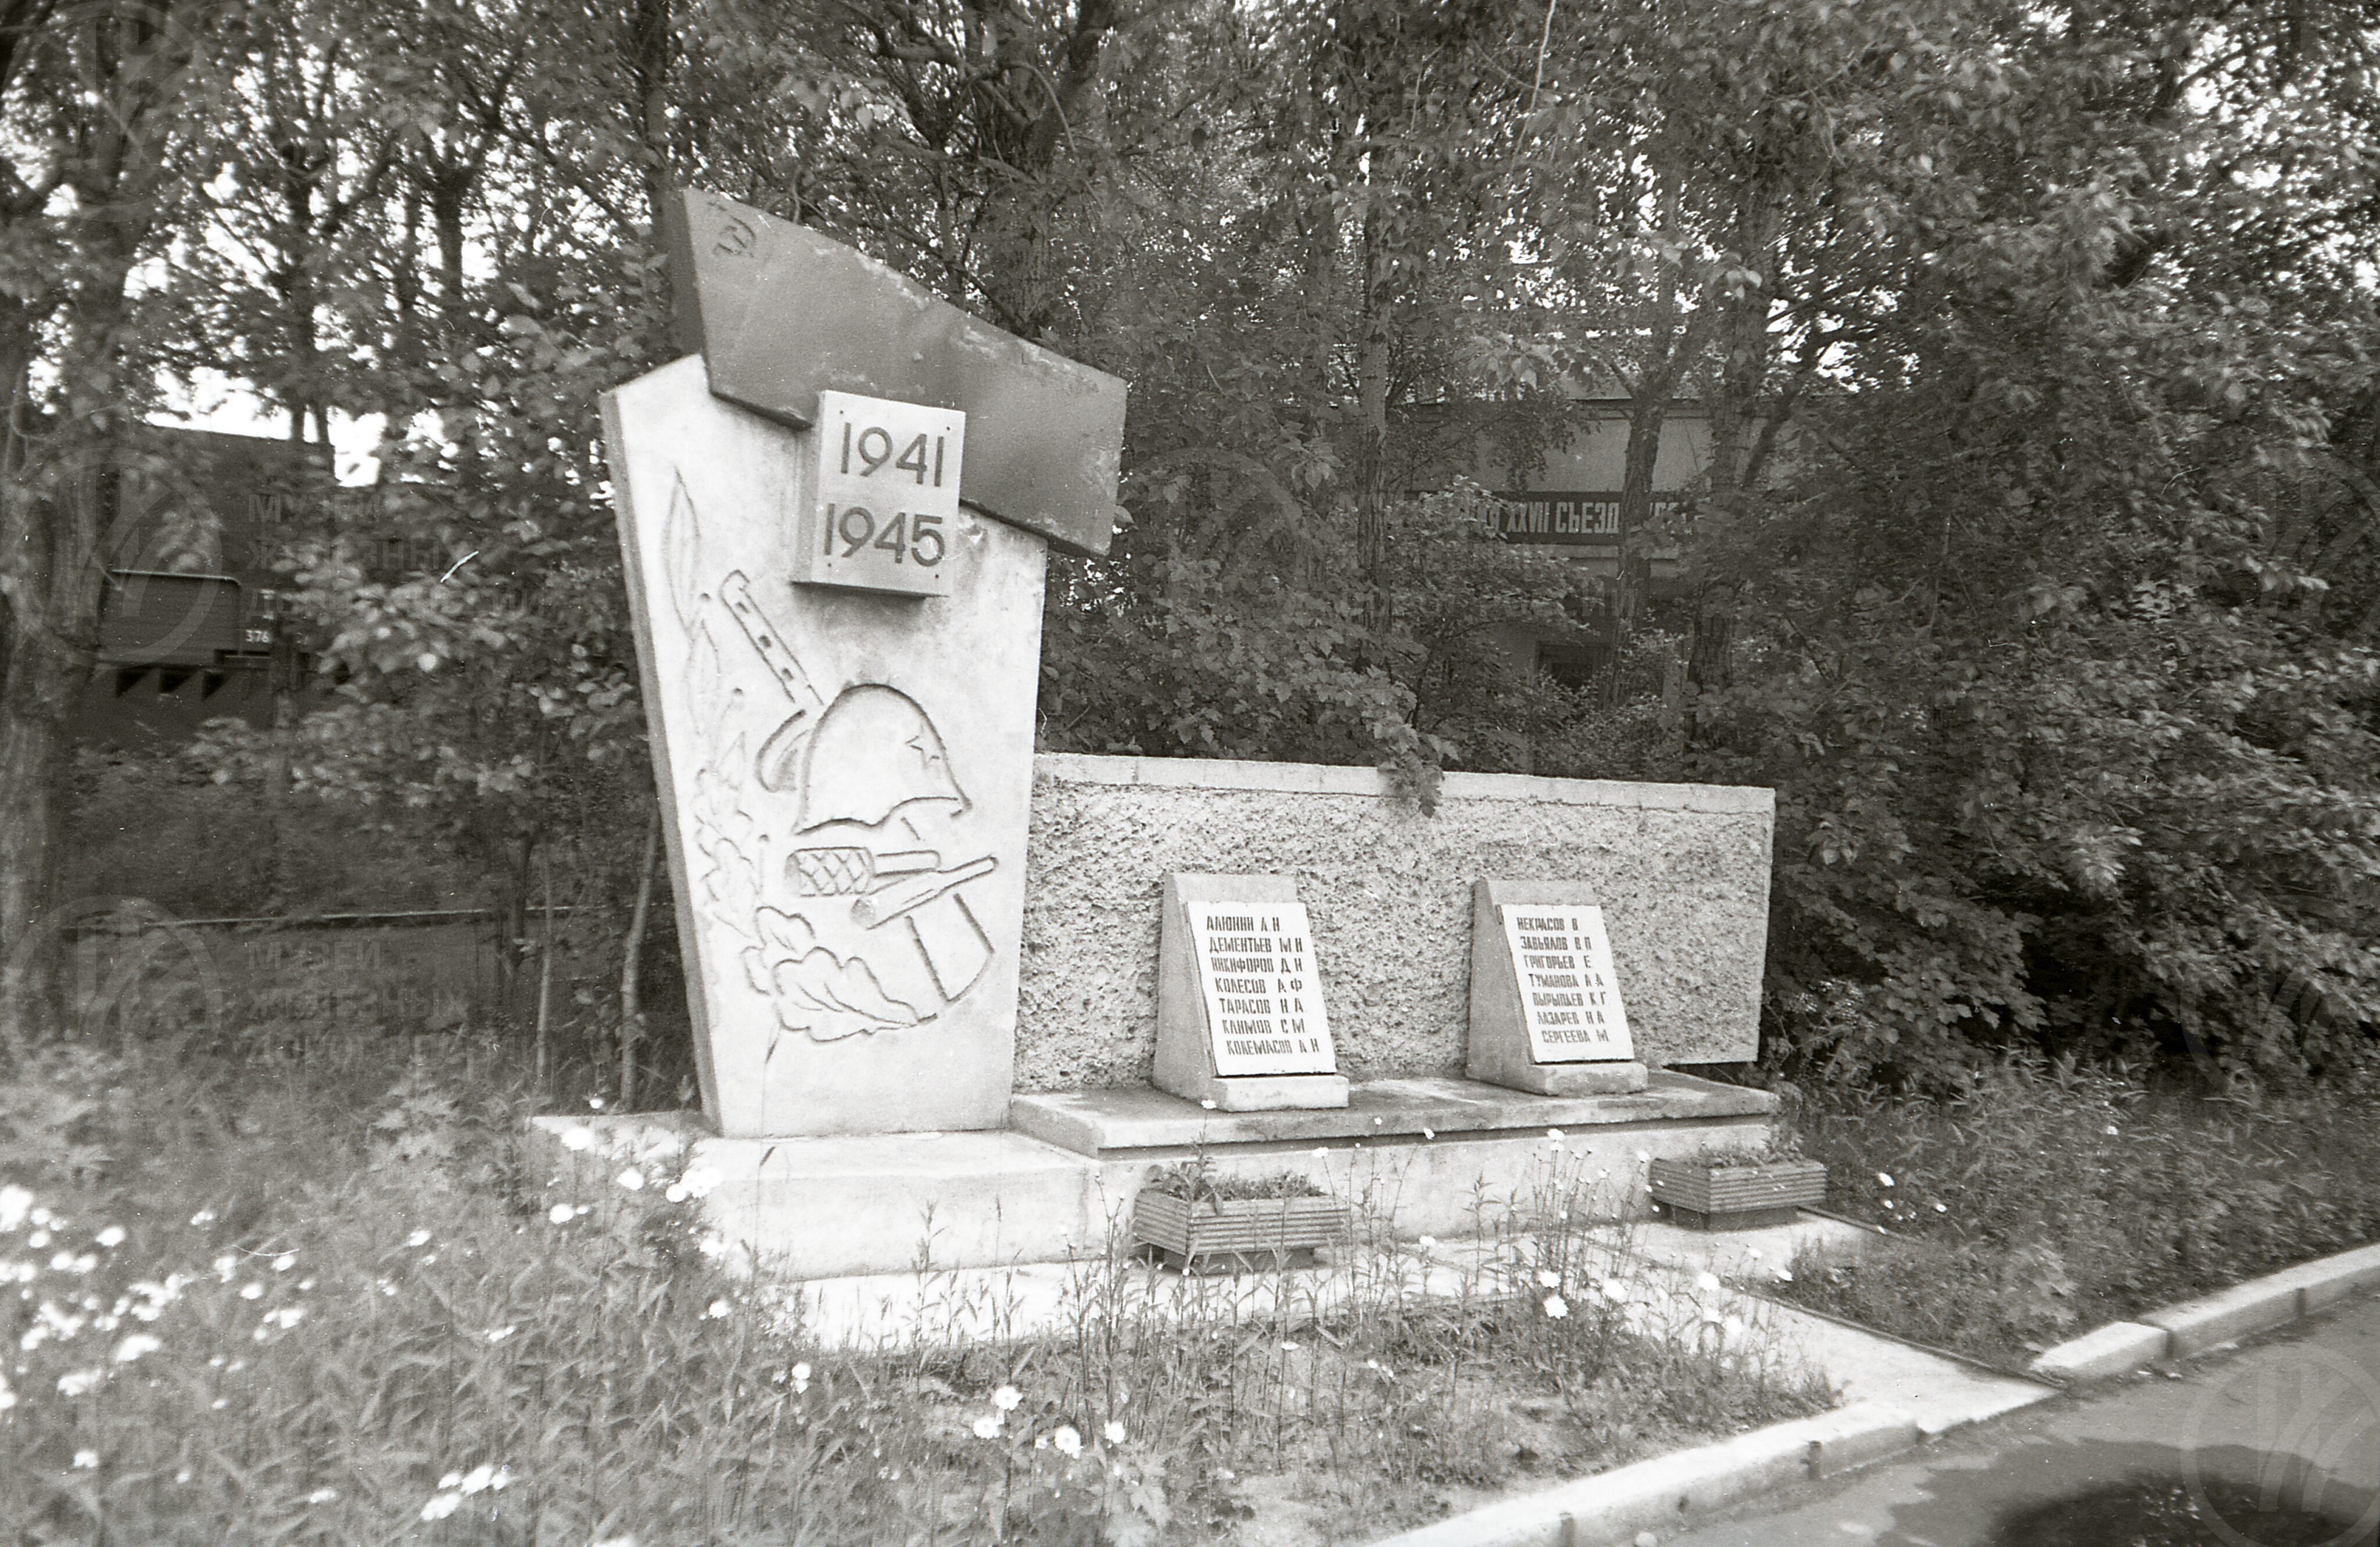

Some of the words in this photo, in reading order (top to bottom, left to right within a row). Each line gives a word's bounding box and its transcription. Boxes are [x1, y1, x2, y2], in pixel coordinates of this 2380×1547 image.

[841, 422, 944, 487] 1941
[1555, 502, 1620, 534] СЪЕЗД
[824, 503, 945, 567] 1945
[1517, 917, 1564, 931] НЕКРАСОВ
[1210, 937, 1271, 953] ДЕМЕНТЬЕВ
[1524, 955, 1575, 969] ГРИГОРЬЕВ
[1216, 978, 1266, 993] КОЛЕСОВ
[1528, 973, 1579, 987] ТУМАНОВА
[1219, 998, 1270, 1014] ТАРАСОВ
[1537, 1012, 1579, 1025] ЛАЗАРЕВ
[1542, 1030, 1590, 1043] СЕРГЕЕВА
